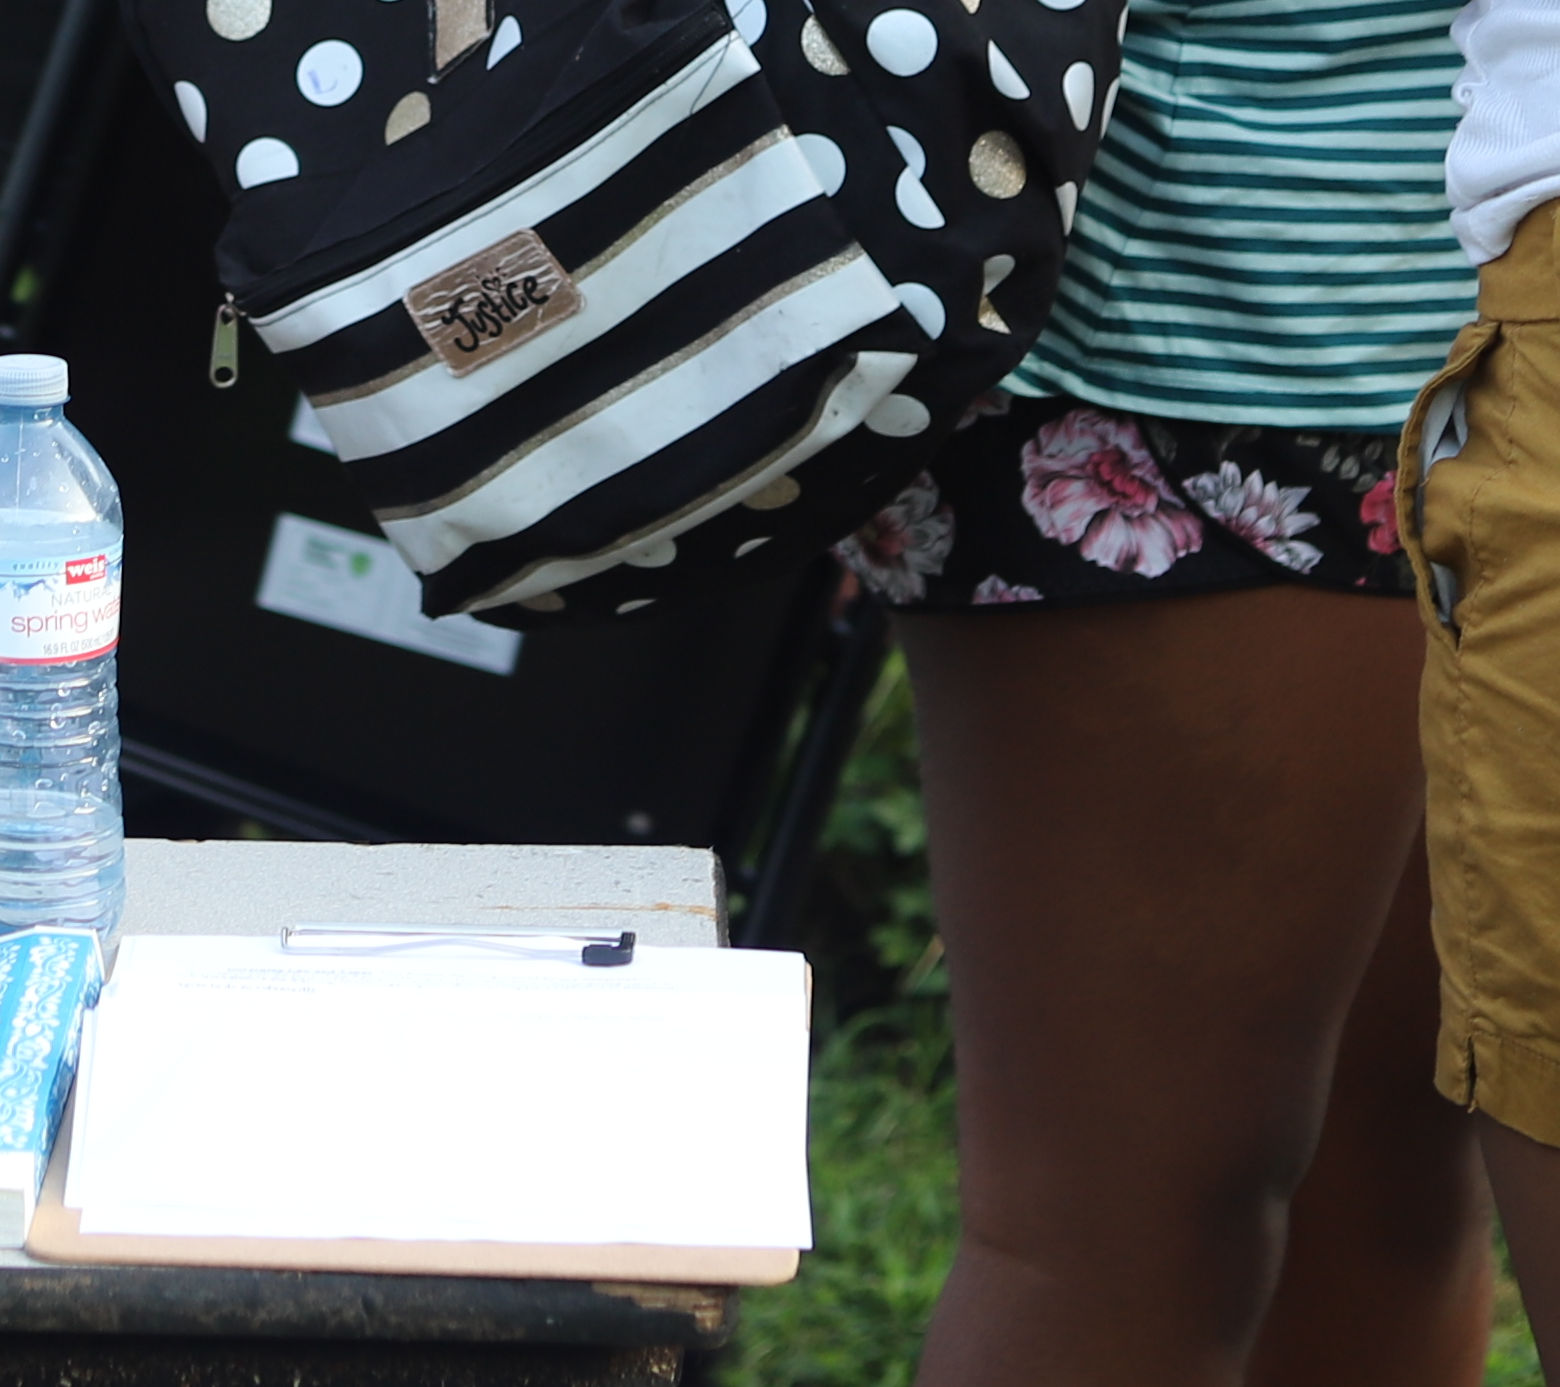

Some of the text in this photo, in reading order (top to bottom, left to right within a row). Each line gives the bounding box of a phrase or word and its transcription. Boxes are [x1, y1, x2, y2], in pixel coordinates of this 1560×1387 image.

[441, 274, 551, 354] Justice
[66, 557, 105, 578] weis
[11, 609, 88, 638] spring
